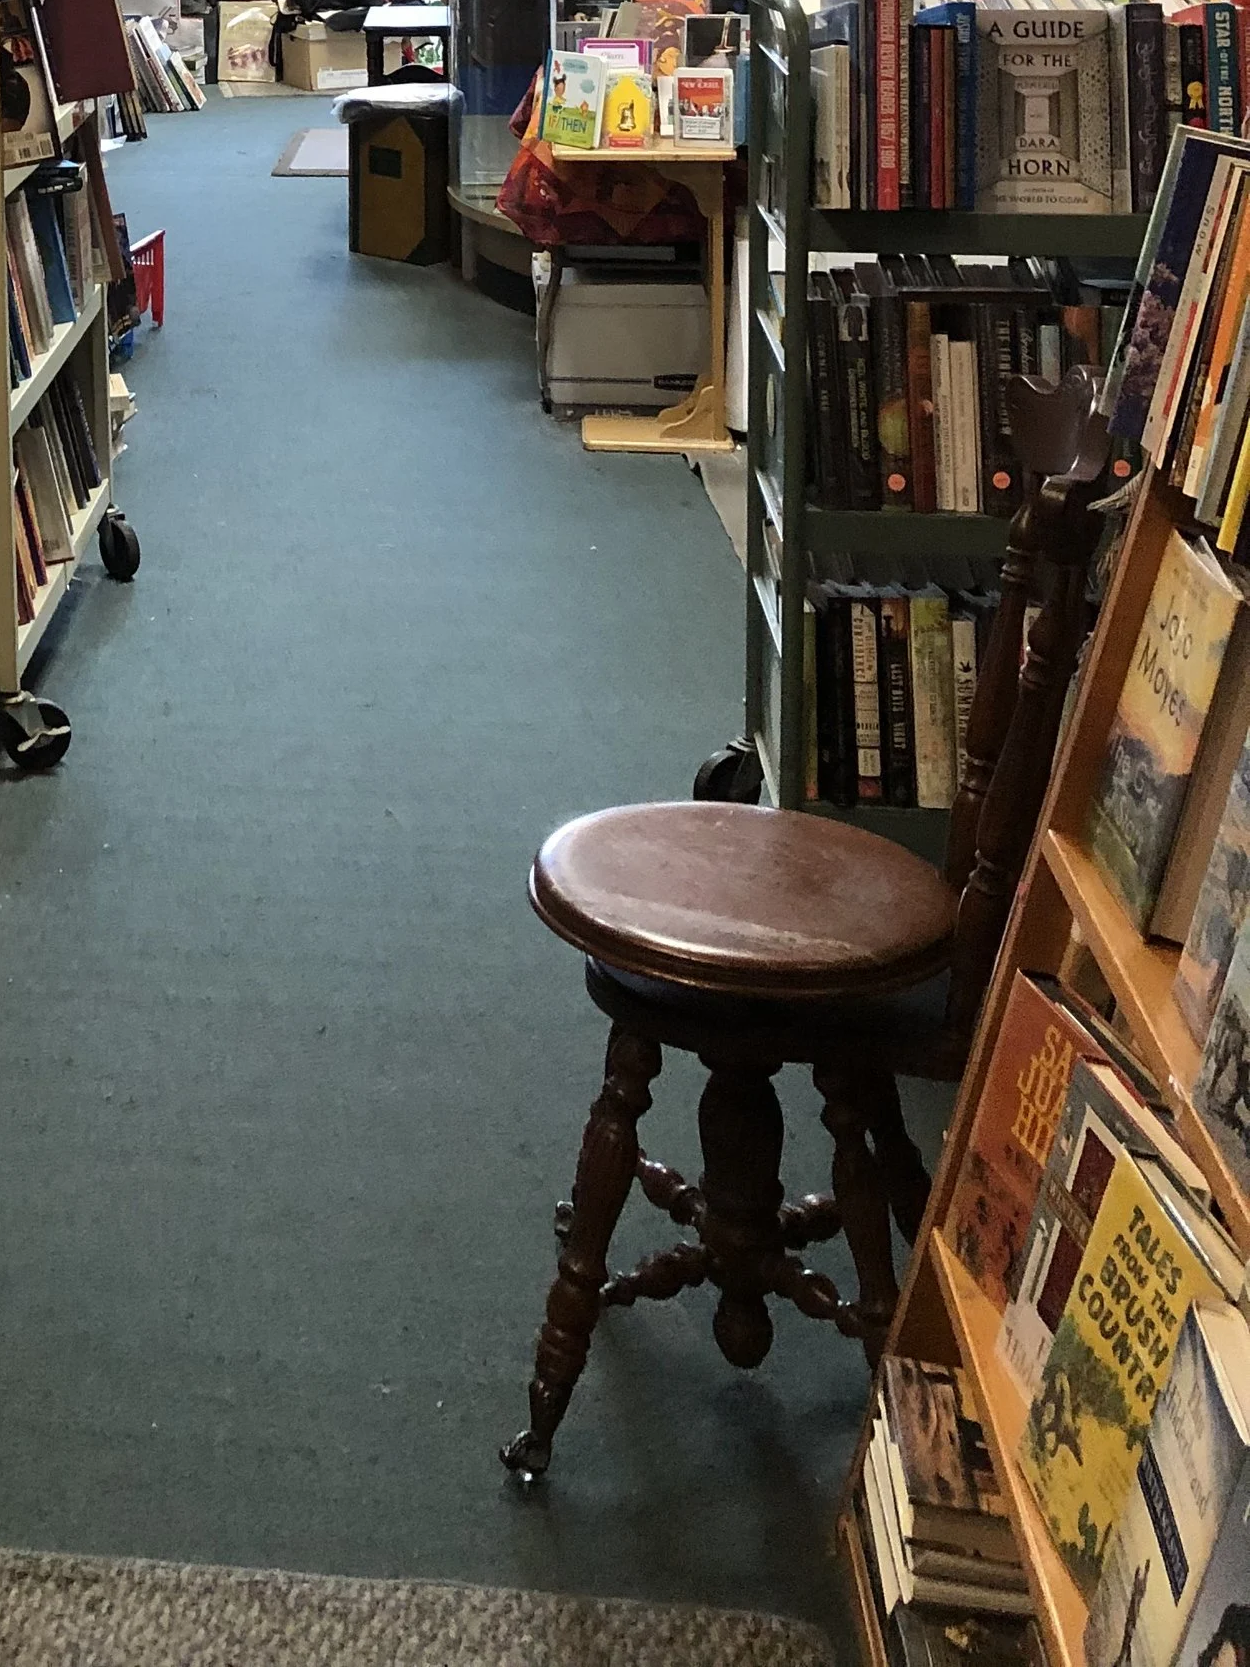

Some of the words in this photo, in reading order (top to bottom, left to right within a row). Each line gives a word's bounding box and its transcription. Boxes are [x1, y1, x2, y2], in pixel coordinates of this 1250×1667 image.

[988, 23, 1003, 38] A
[1013, 20, 1086, 39] GUIDE
[1216, 11, 1231, 48] STAR
[879, 44, 896, 78] REVIEW
[1003, 53, 1034, 67] FOR
[1042, 53, 1072, 67] THE
[879, 80, 896, 115] READER
[1019, 136, 1057, 149] DARA
[1008, 158, 1071, 176] HORN
[1194, 205, 1216, 257] Snow
[1159, 594, 1195, 661] Jojo
[1138, 642, 1187, 727] Moyes
[1126, 1204, 1183, 1297] TALES
[1111, 1232, 1150, 1289] FROM
[1151, 1287, 1178, 1333] THE
[1098, 1254, 1170, 1370] BRUSH
